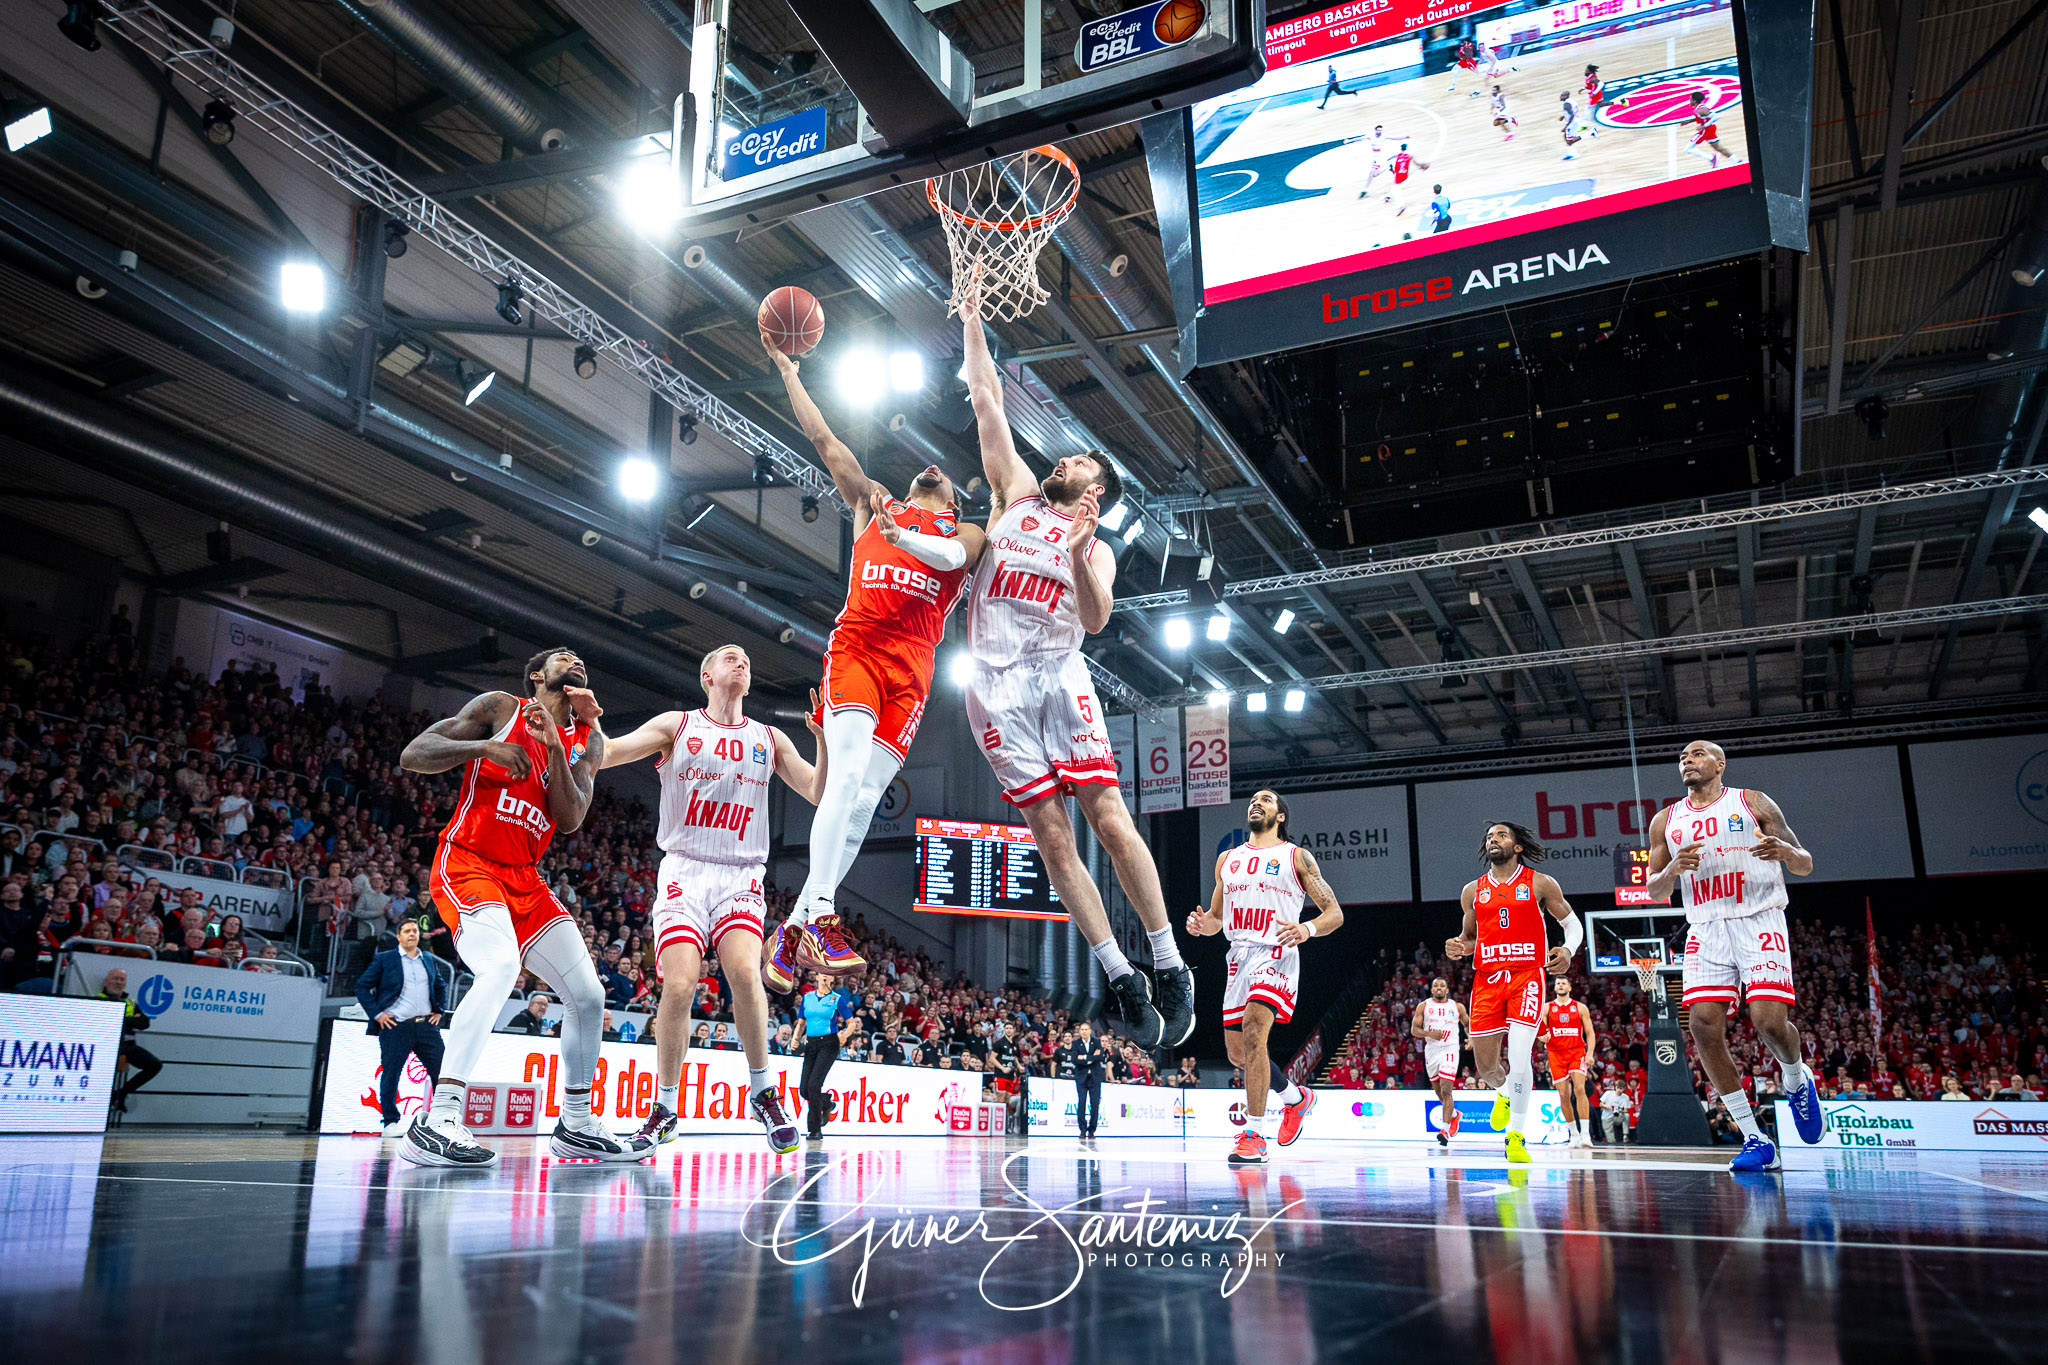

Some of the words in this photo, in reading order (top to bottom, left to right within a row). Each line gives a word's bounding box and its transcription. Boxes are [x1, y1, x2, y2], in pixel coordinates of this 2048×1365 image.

[1405, 14, 1424, 27] 3rd
[1427, 2, 1472, 21] Quarter
[1105, 22, 1142, 40] Credit
[1266, 16, 1321, 42] AMBERG
[1329, 17, 1376, 37] teamfoul
[1267, 38, 1306, 55] timeout
[1350, 34, 1358, 44] 0
[1090, 35, 1141, 66] BBL
[754, 132, 818, 165] Credit
[1322, 276, 1452, 324] brose
[1461, 243, 1611, 295] ARENA
[1043, 527, 1066, 543] 5
[992, 537, 1040, 556] s.Oliver
[861, 560, 941, 597] brose
[861, 582, 888, 590] Technik
[987, 560, 1068, 613] KNAUF
[1077, 695, 1093, 723] 5
[714, 738, 744, 762] 40
[1187, 738, 1228, 769] 23
[1150, 746, 1169, 775] 6
[679, 767, 724, 781] s.Oliver
[1141, 776, 1180, 789] brose
[1188, 770, 1228, 782] brose
[1141, 786, 1181, 797] bamberg
[1188, 780, 1228, 790] baskets
[685, 789, 754, 841] KNAUF
[1536, 791, 1665, 840] bro
[1692, 816, 1719, 842] 20
[1348, 847, 1388, 859] GMBH
[1247, 857, 1260, 875] 0
[1690, 872, 1746, 906] KNAUF
[208, 894, 281, 918] ARENA
[1500, 908, 1509, 928] 3
[1480, 942, 1536, 958] brose
[1759, 932, 1786, 953] 20
[184, 986, 266, 1005] IGARASHI
[182, 1001, 233, 1013] MOTOREN
[235, 1006, 264, 1016] GMBH
[470, 1091, 493, 1104] RHÖN
[510, 1093, 533, 1104] RHÖN
[1836, 1115, 1914, 1129] Holzbau
[1976, 1122, 2008, 1133] DAS
[1839, 1129, 1883, 1146] Übel
[1886, 1139, 1916, 1147] GmbH
